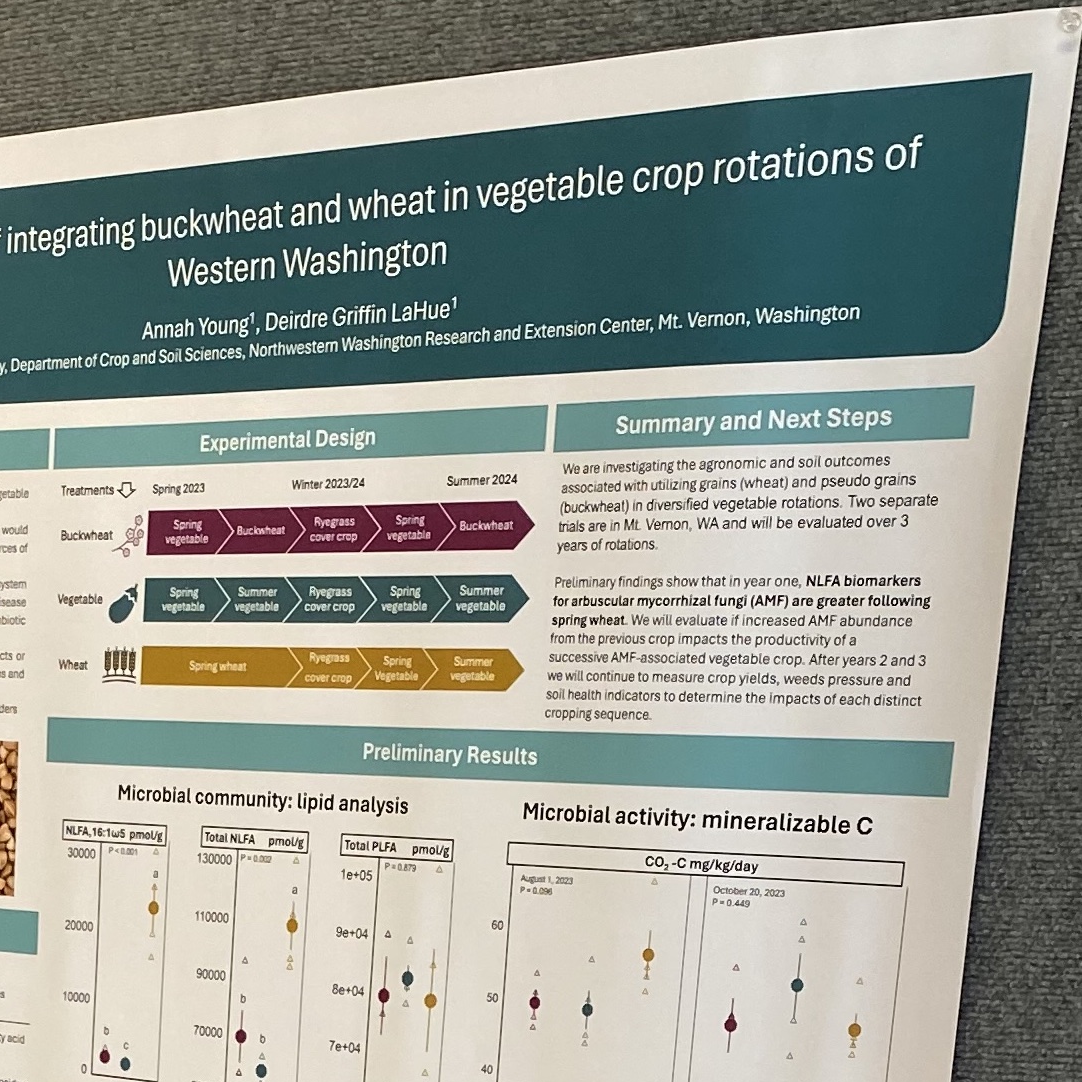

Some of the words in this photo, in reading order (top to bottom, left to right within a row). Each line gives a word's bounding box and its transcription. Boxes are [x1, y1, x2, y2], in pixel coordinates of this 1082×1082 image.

[7, 216, 136, 257] integrating
[141, 201, 284, 242] buckwheat
[290, 192, 341, 227] and
[347, 185, 437, 221] wheat
[443, 180, 469, 212] in
[475, 164, 624, 214] vegetable
[632, 161, 704, 196] crop
[713, 143, 874, 184] rotations
[885, 134, 924, 171] of
[167, 256, 276, 287] Western
[282, 239, 447, 278] Washington
[141, 318, 195, 340] Annah
[265, 309, 328, 332] Deirdre
[332, 303, 387, 327] Griffin
[10, 355, 83, 375] Department
[84, 353, 98, 368] of
[99, 352, 130, 369] Crop
[132, 349, 157, 366] and
[158, 347, 183, 364] Soil
[184, 346, 246, 362] Sciences,
[249, 340, 339, 358] Northwestern
[341, 334, 422, 353] Washington
[424, 327, 491, 347] Research
[493, 324, 521, 342] and
[524, 320, 597, 340] Extension
[599, 317, 654, 335] Center,
[687, 311, 751, 328] Vernon,
[755, 305, 860, 326] Washington
[615, 415, 716, 436] Summary
[720, 410, 763, 431] and
[768, 409, 822, 429] Next
[826, 407, 892, 431] Steps
[200, 430, 312, 456] Experimental
[315, 427, 376, 451] Design
[562, 463, 581, 475] We
[582, 464, 601, 475] are
[602, 460, 675, 475] investigating
[676, 459, 697, 471] the
[698, 459, 767, 473] agronomic
[769, 456, 795, 469] and
[797, 455, 822, 469] soil
[824, 455, 891, 468] outcomes
[291, 479, 324, 490] Winter
[324, 477, 365, 489] 2023/24
[446, 475, 491, 487] Summer
[491, 473, 518, 486] 2024
[61, 485, 115, 497] Treatments
[152, 483, 182, 497] Spring
[182, 482, 205, 494] 2023
[173, 519, 203, 532] Spring
[314, 516, 356, 529] Ryegrass
[60, 529, 114, 541] Buckwheat
[236, 525, 286, 536] Buckwheat
[165, 533, 209, 547] vegetable
[309, 533, 336, 542] cover
[336, 533, 358, 543] crop
[57, 593, 103, 607] Vegetable
[58, 659, 89, 671] Wheat
[363, 742, 464, 767] Preliminary
[467, 745, 538, 766] Results
[118, 784, 192, 804] Microbial
[195, 790, 293, 813] community:
[297, 792, 335, 814] lipid
[338, 795, 409, 818] analysis
[523, 802, 611, 824] Microbial
[615, 807, 696, 832] activity:
[702, 809, 851, 835] mineralizable
[856, 816, 873, 836] C
[67, 846, 96, 860] 30000
[344, 839, 370, 851] Total
[371, 841, 397, 853] PLFA
[412, 845, 450, 859] pmol/g
[64, 919, 94, 932] 20000
[491, 919, 504, 931] 60
[62, 990, 91, 1004] 10000
[486, 992, 499, 1003] 50
[480, 1064, 494, 1075] 40
